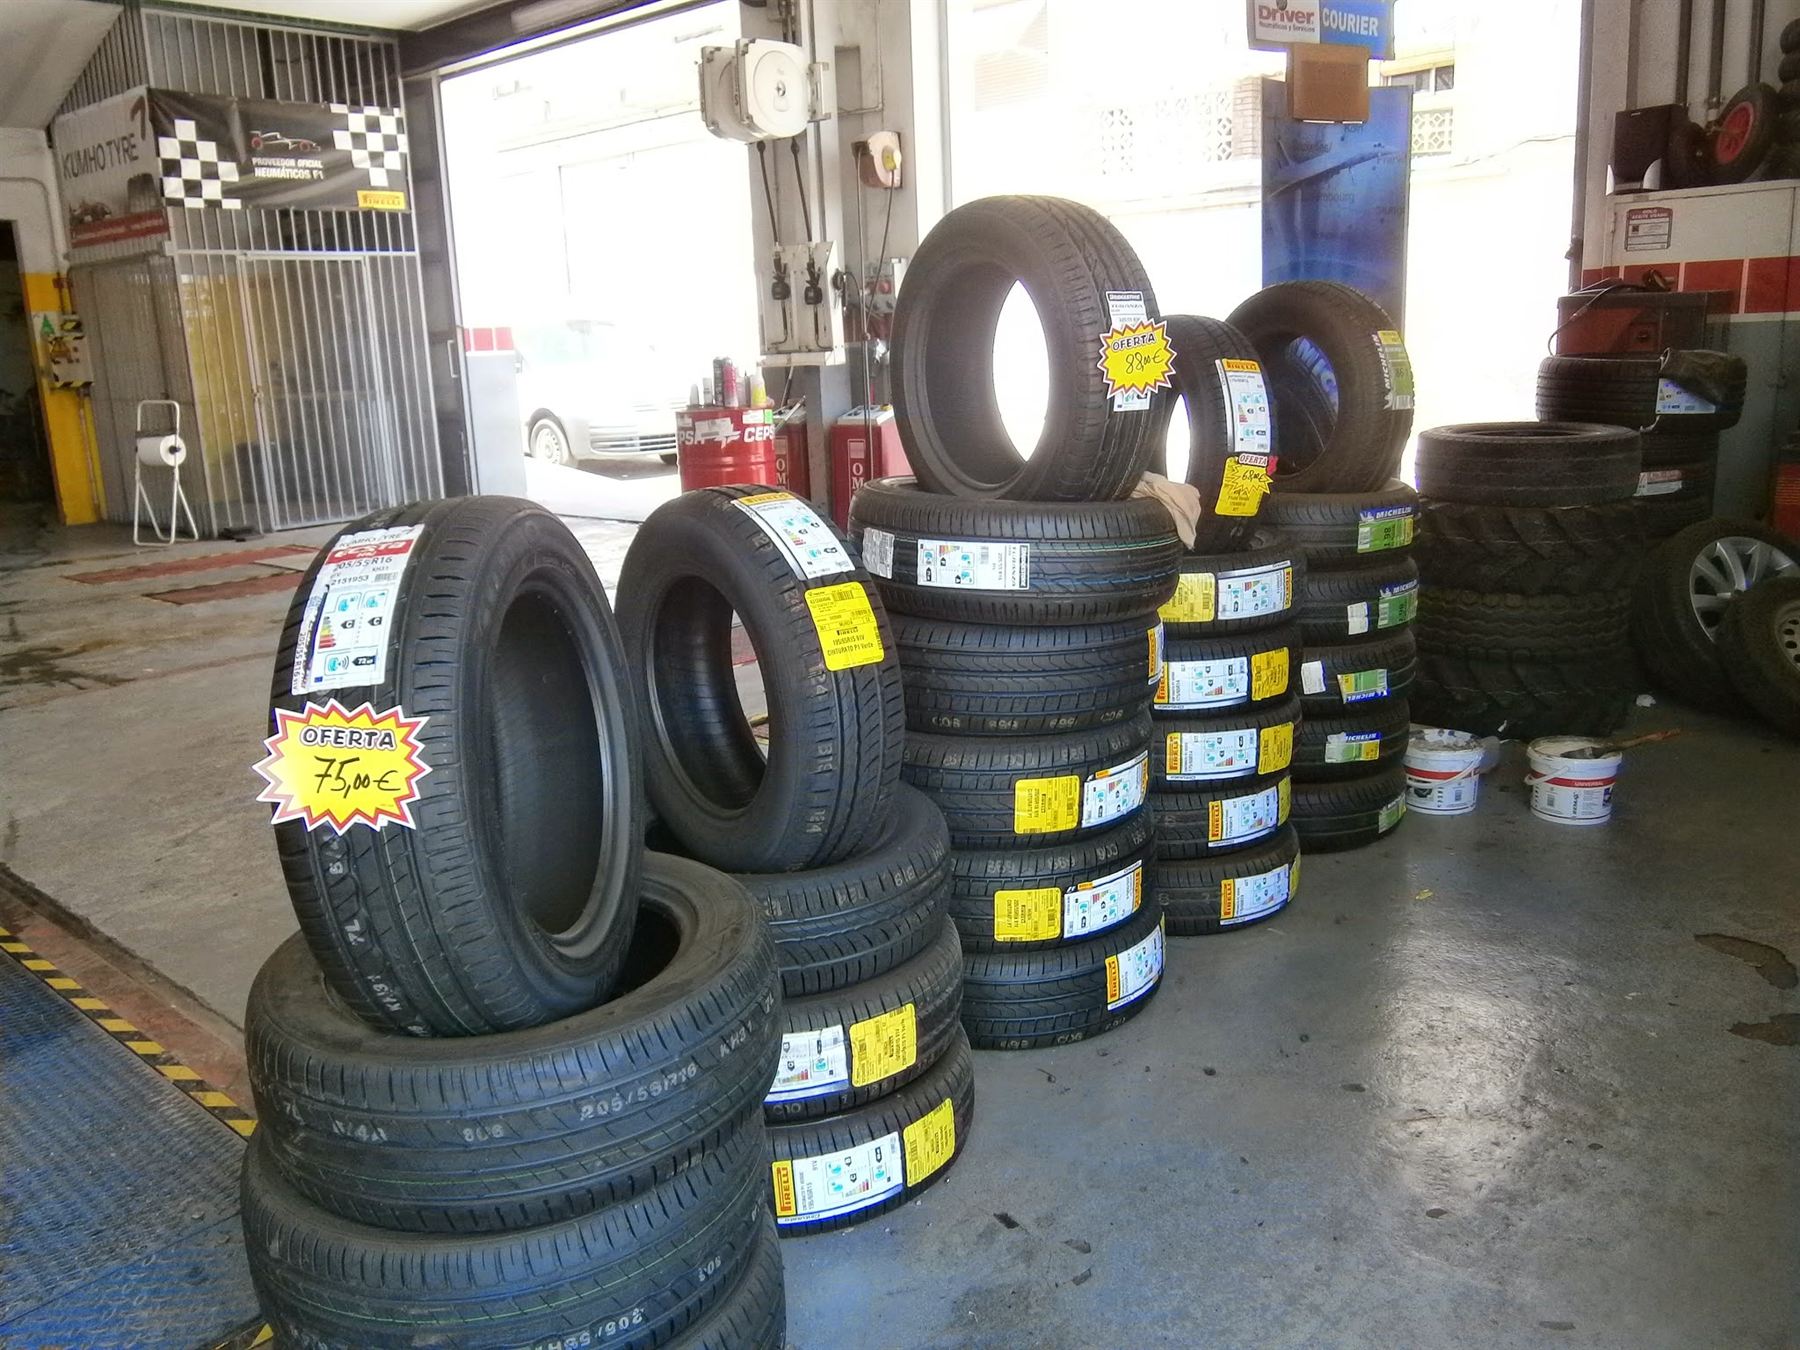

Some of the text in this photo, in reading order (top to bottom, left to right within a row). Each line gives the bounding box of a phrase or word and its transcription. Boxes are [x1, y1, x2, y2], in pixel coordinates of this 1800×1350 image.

[1258, 5, 1315, 25] Driver
[1322, 8, 1378, 36] COURIER
[62, 133, 138, 179] KUMHO TYRE
[252, 157, 323, 169] PROVEEDOR OFICIAL
[254, 167, 324, 180] NEUMÁTICOS F1
[1112, 333, 1156, 351] OFERTA
[1240, 454, 1267, 466] OFERTA
[1375, 507, 1412, 518] MICHELIN
[302, 728, 395, 748] OFERTA
[1211, 802, 1219, 838] PIRELLI
[1108, 960, 1118, 999] PIRELLI
[775, 1166, 793, 1212] PIRELLI
